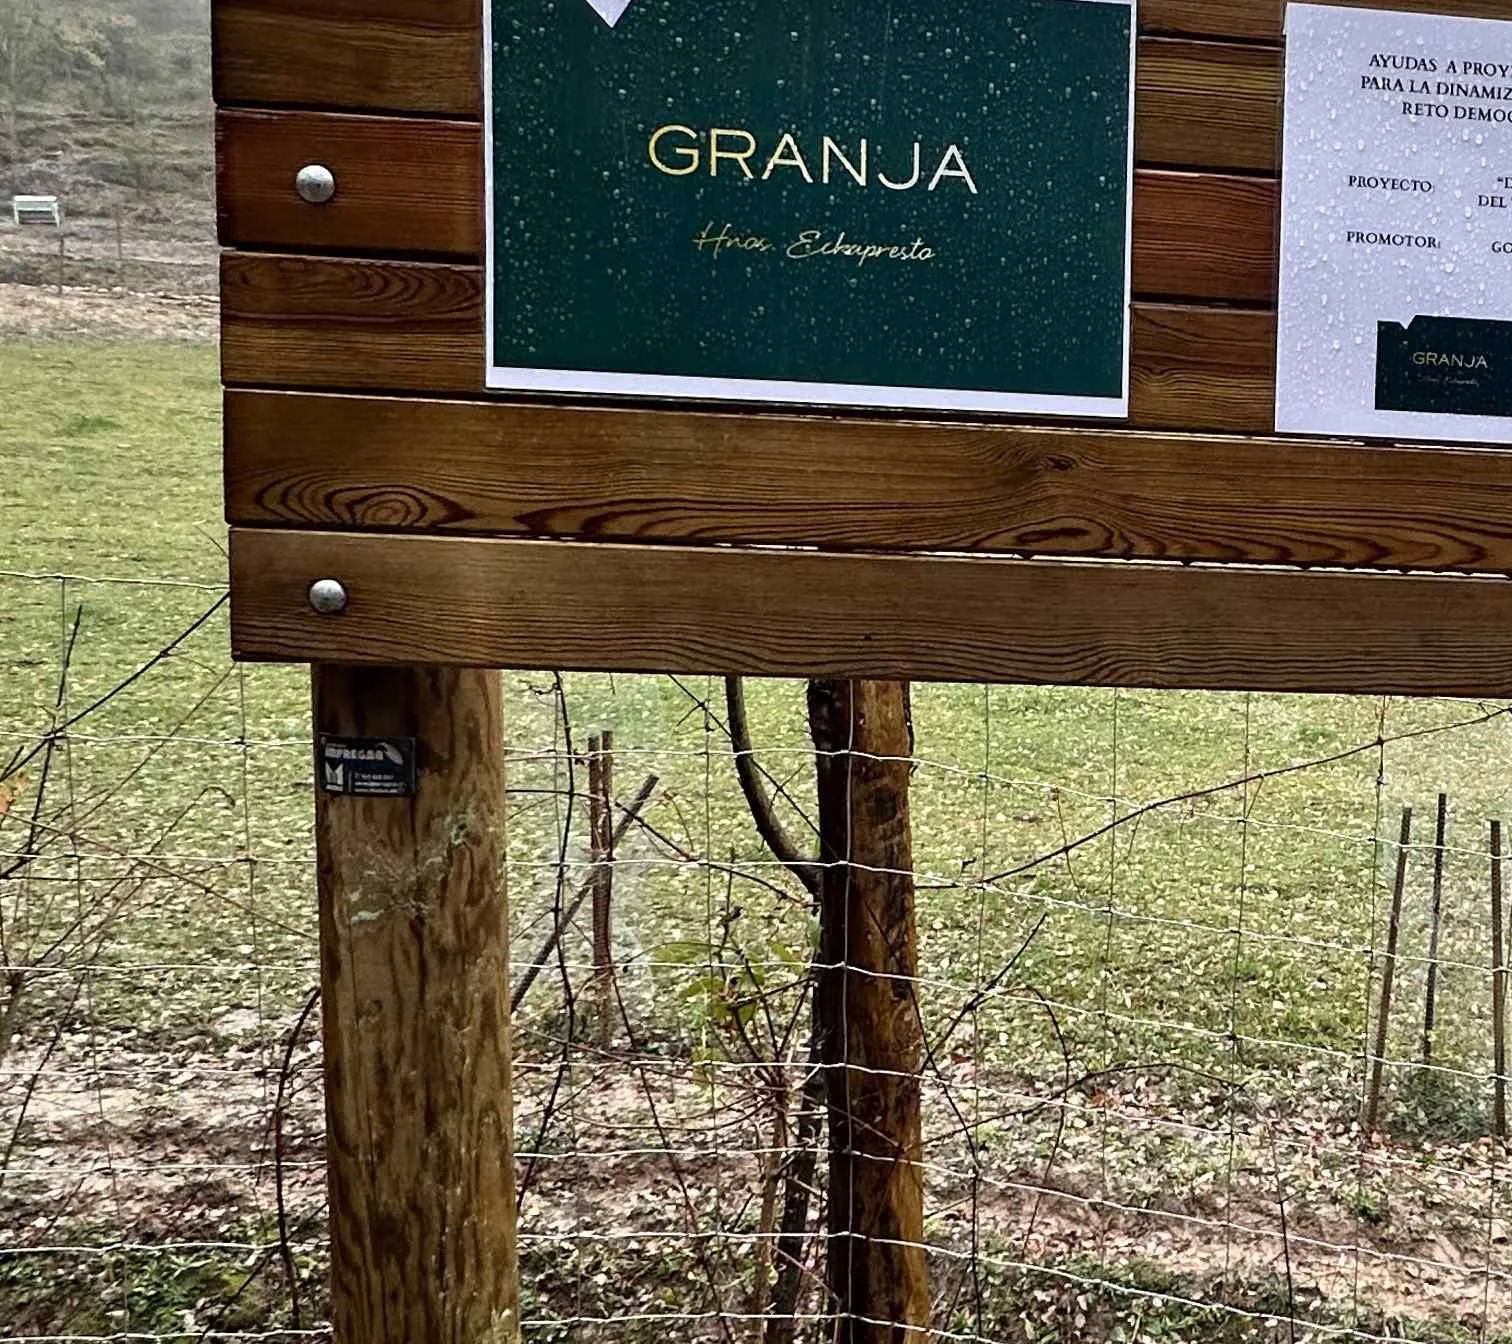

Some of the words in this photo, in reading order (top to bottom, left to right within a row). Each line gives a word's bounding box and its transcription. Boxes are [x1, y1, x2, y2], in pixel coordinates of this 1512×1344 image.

[1368, 53, 1438, 73] AYUDAS
[1446, 59, 1458, 74] A
[1360, 75, 1405, 93] PARA
[1409, 79, 1431, 95] LA
[1401, 101, 1449, 119] RETO
[649, 124, 978, 194] GRANJA
[1477, 194, 1508, 209] DEL
[1411, 351, 1489, 369] GRANJA
